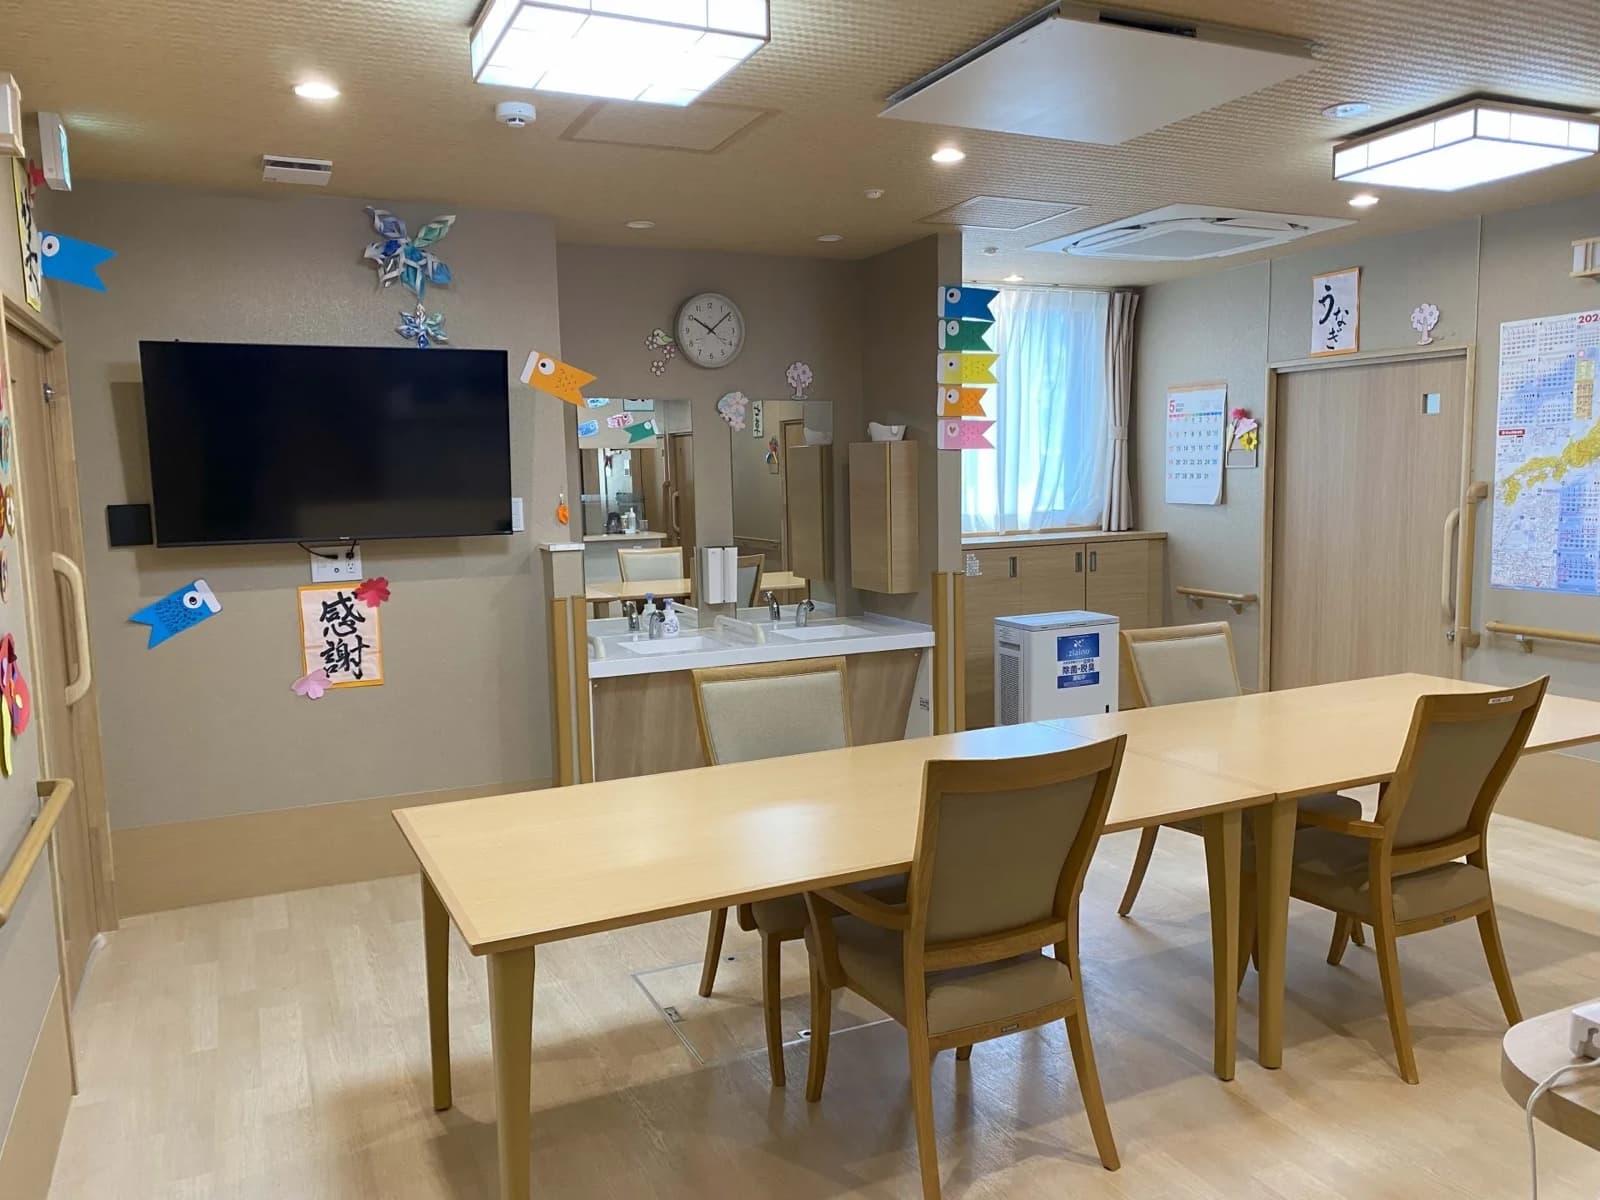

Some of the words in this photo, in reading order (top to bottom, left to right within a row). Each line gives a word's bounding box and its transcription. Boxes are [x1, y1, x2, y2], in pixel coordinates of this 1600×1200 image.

[1318, 284, 1349, 350] うなぎ
[1578, 313, 1600, 324] 202
[1169, 400, 1176, 413] 5
[319, 591, 371, 680] 感謝
